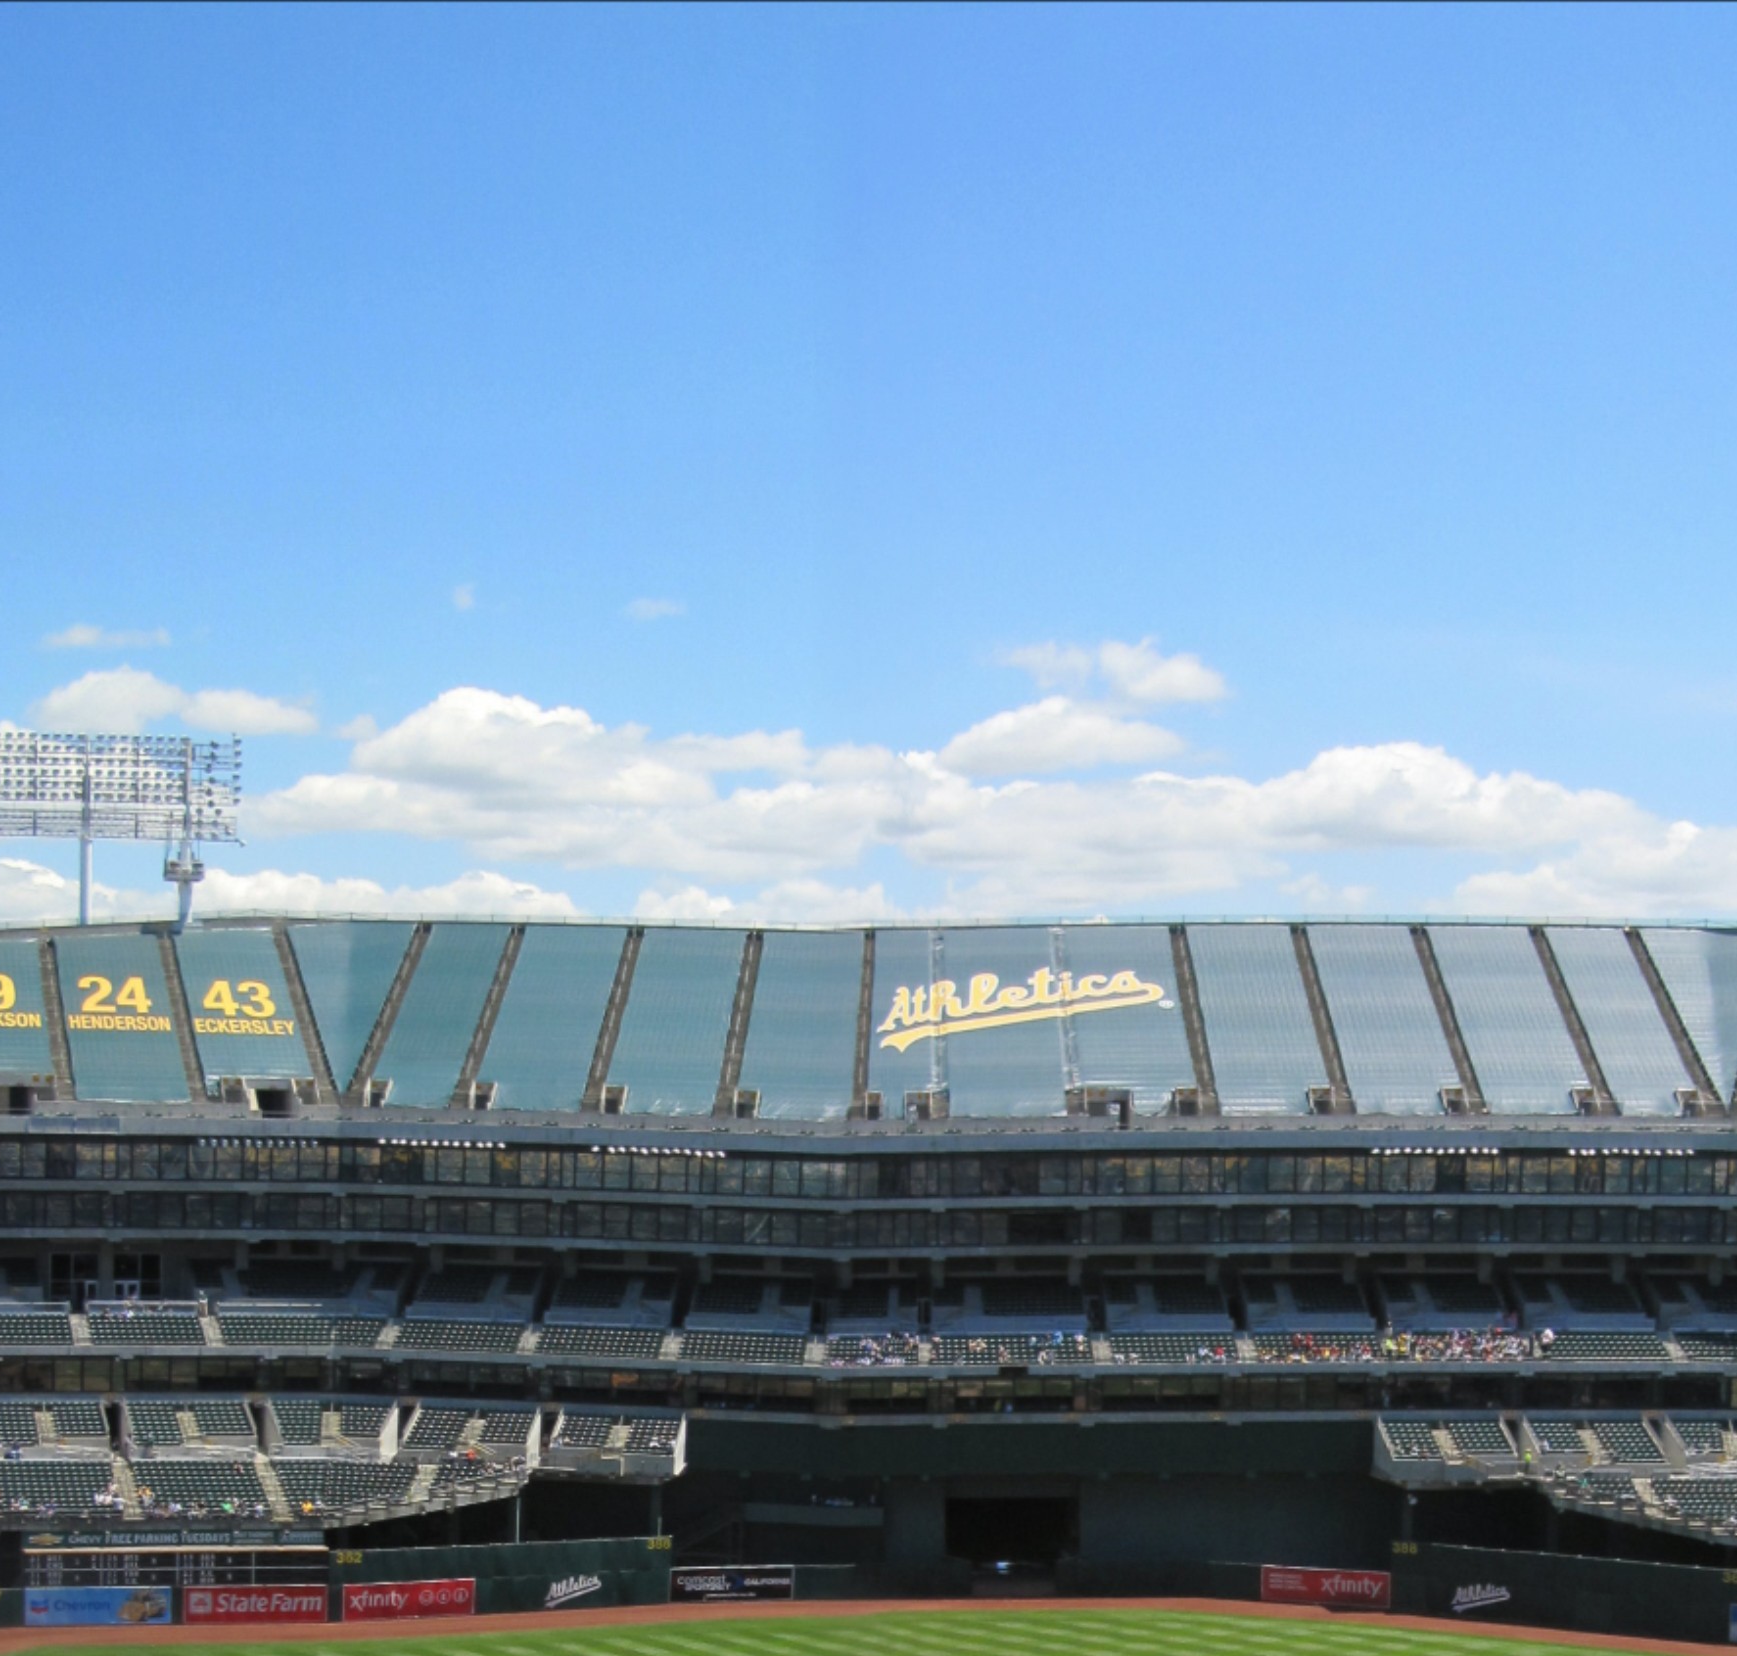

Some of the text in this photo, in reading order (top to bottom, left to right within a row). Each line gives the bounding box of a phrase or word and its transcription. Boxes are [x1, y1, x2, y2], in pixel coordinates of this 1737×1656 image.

[76, 976, 152, 1014] 24
[202, 979, 276, 1018] 43
[877, 966, 1165, 1040] Athletics
[68, 1014, 171, 1033] HENDERSON
[194, 1017, 295, 1037] ECKERSLEY
[68, 1536, 103, 1545] CHEVY
[105, 1532, 133, 1545] FREE
[134, 1532, 178, 1545] PARKING
[180, 1532, 230, 1544] TUESDAYS
[1320, 1575, 1385, 1600] xfinity
[215, 1594, 323, 1613] State Farm
[349, 1590, 409, 1611] xfinity
